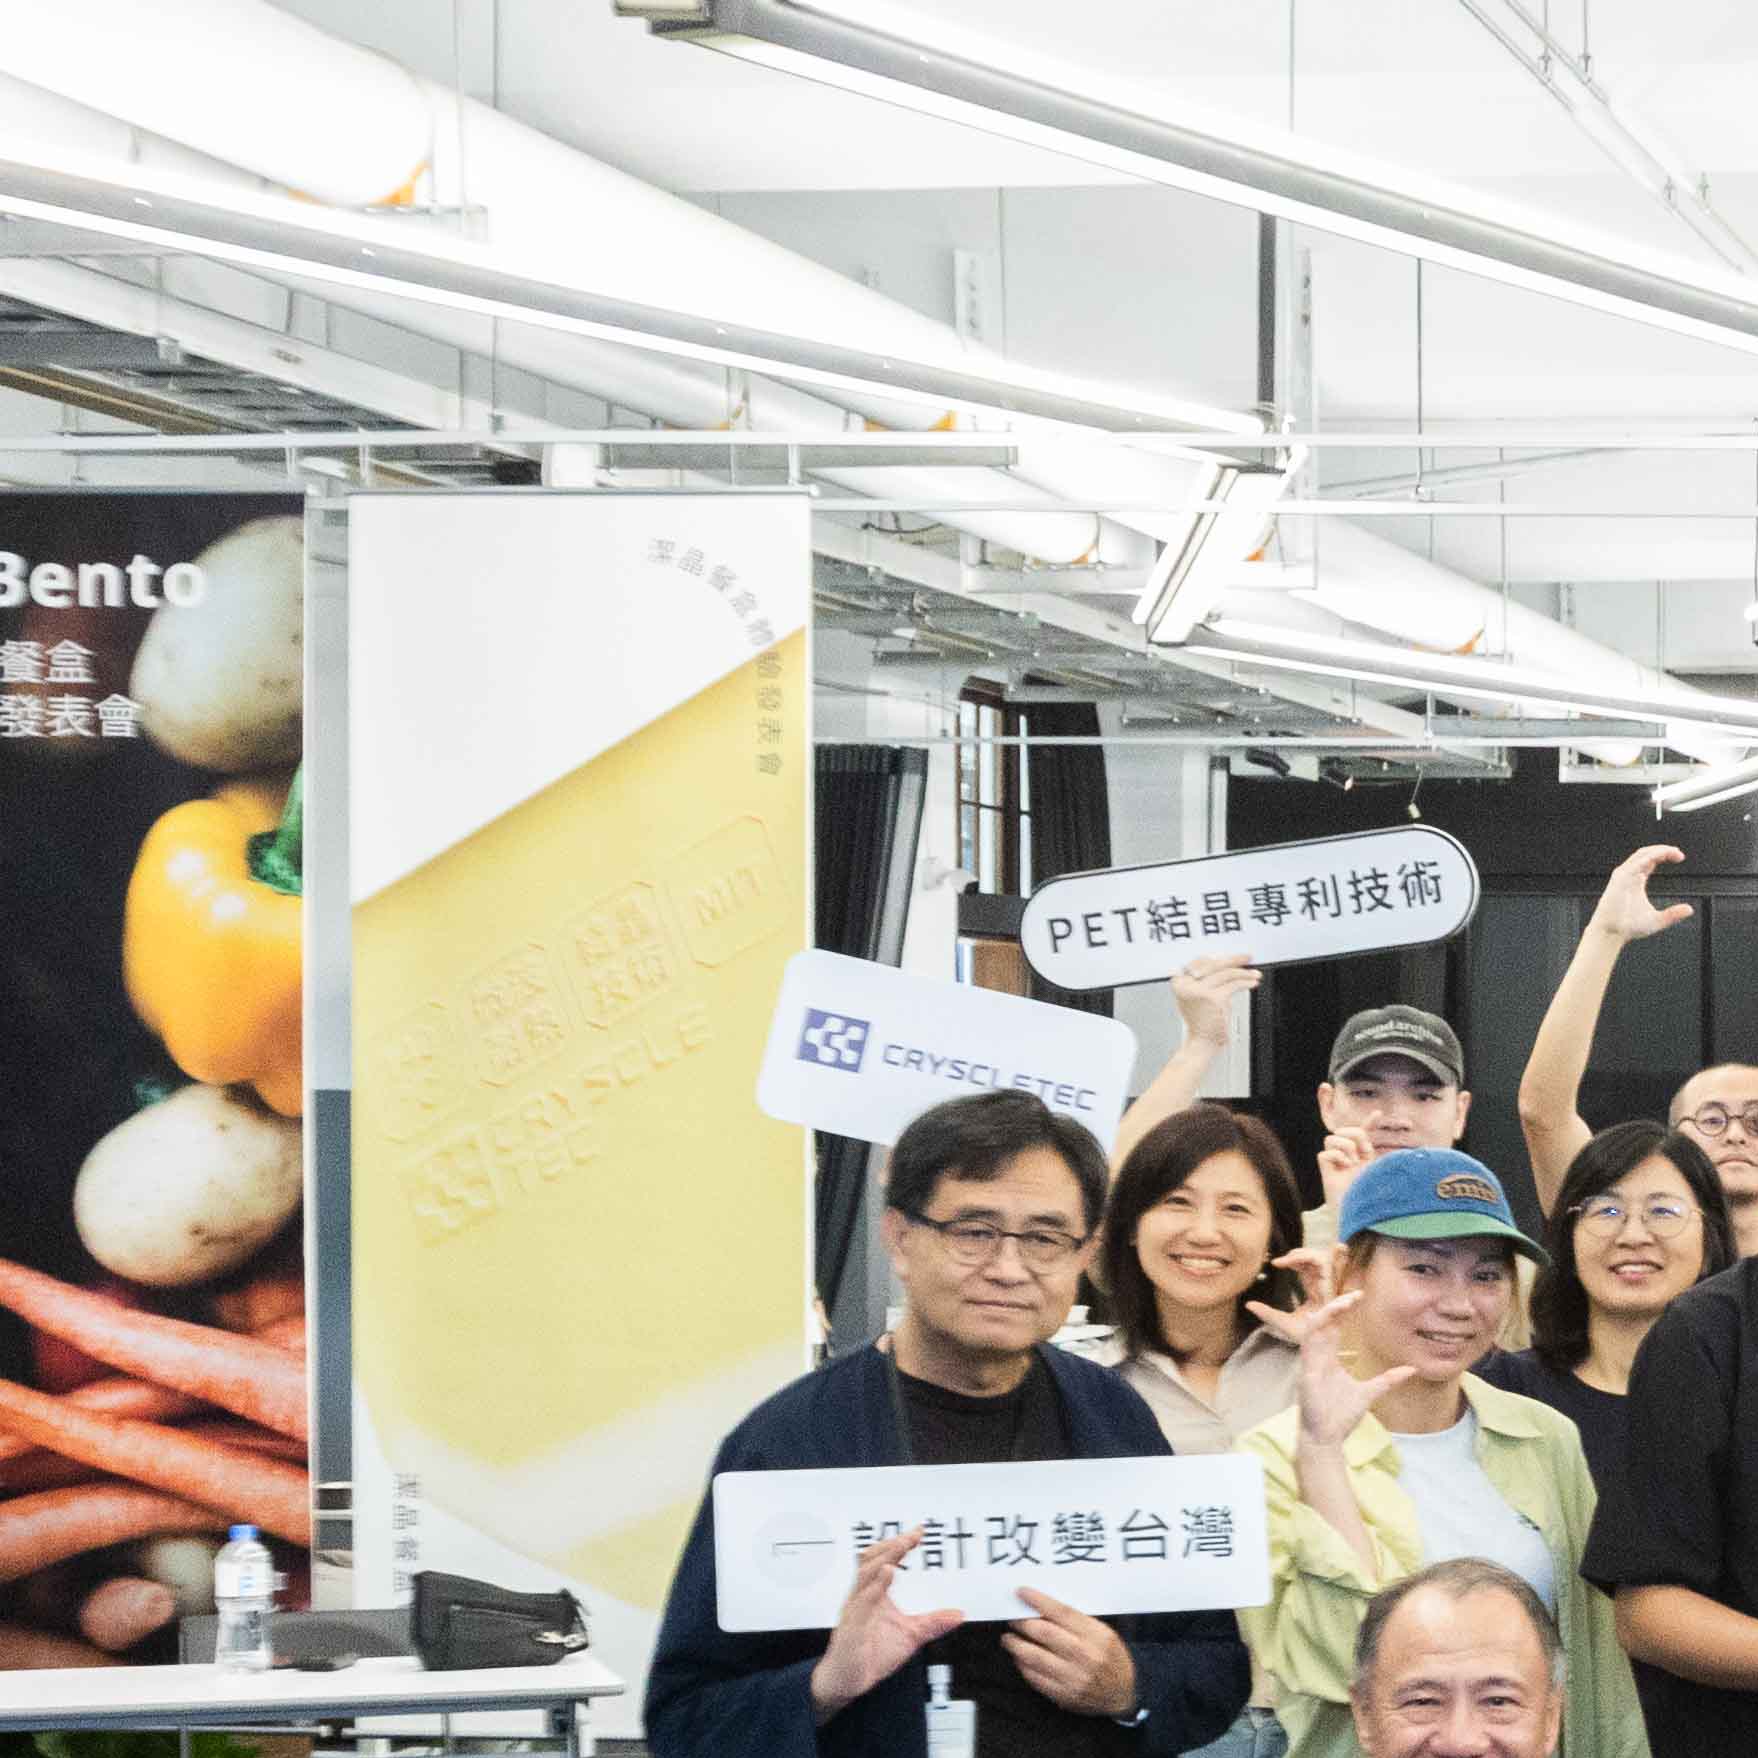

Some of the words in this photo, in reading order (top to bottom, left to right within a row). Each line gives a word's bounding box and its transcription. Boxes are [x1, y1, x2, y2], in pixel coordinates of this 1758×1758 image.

[0, 692, 144, 738] 發表會
[1048, 858, 1444, 954] PET結晶專利技術
